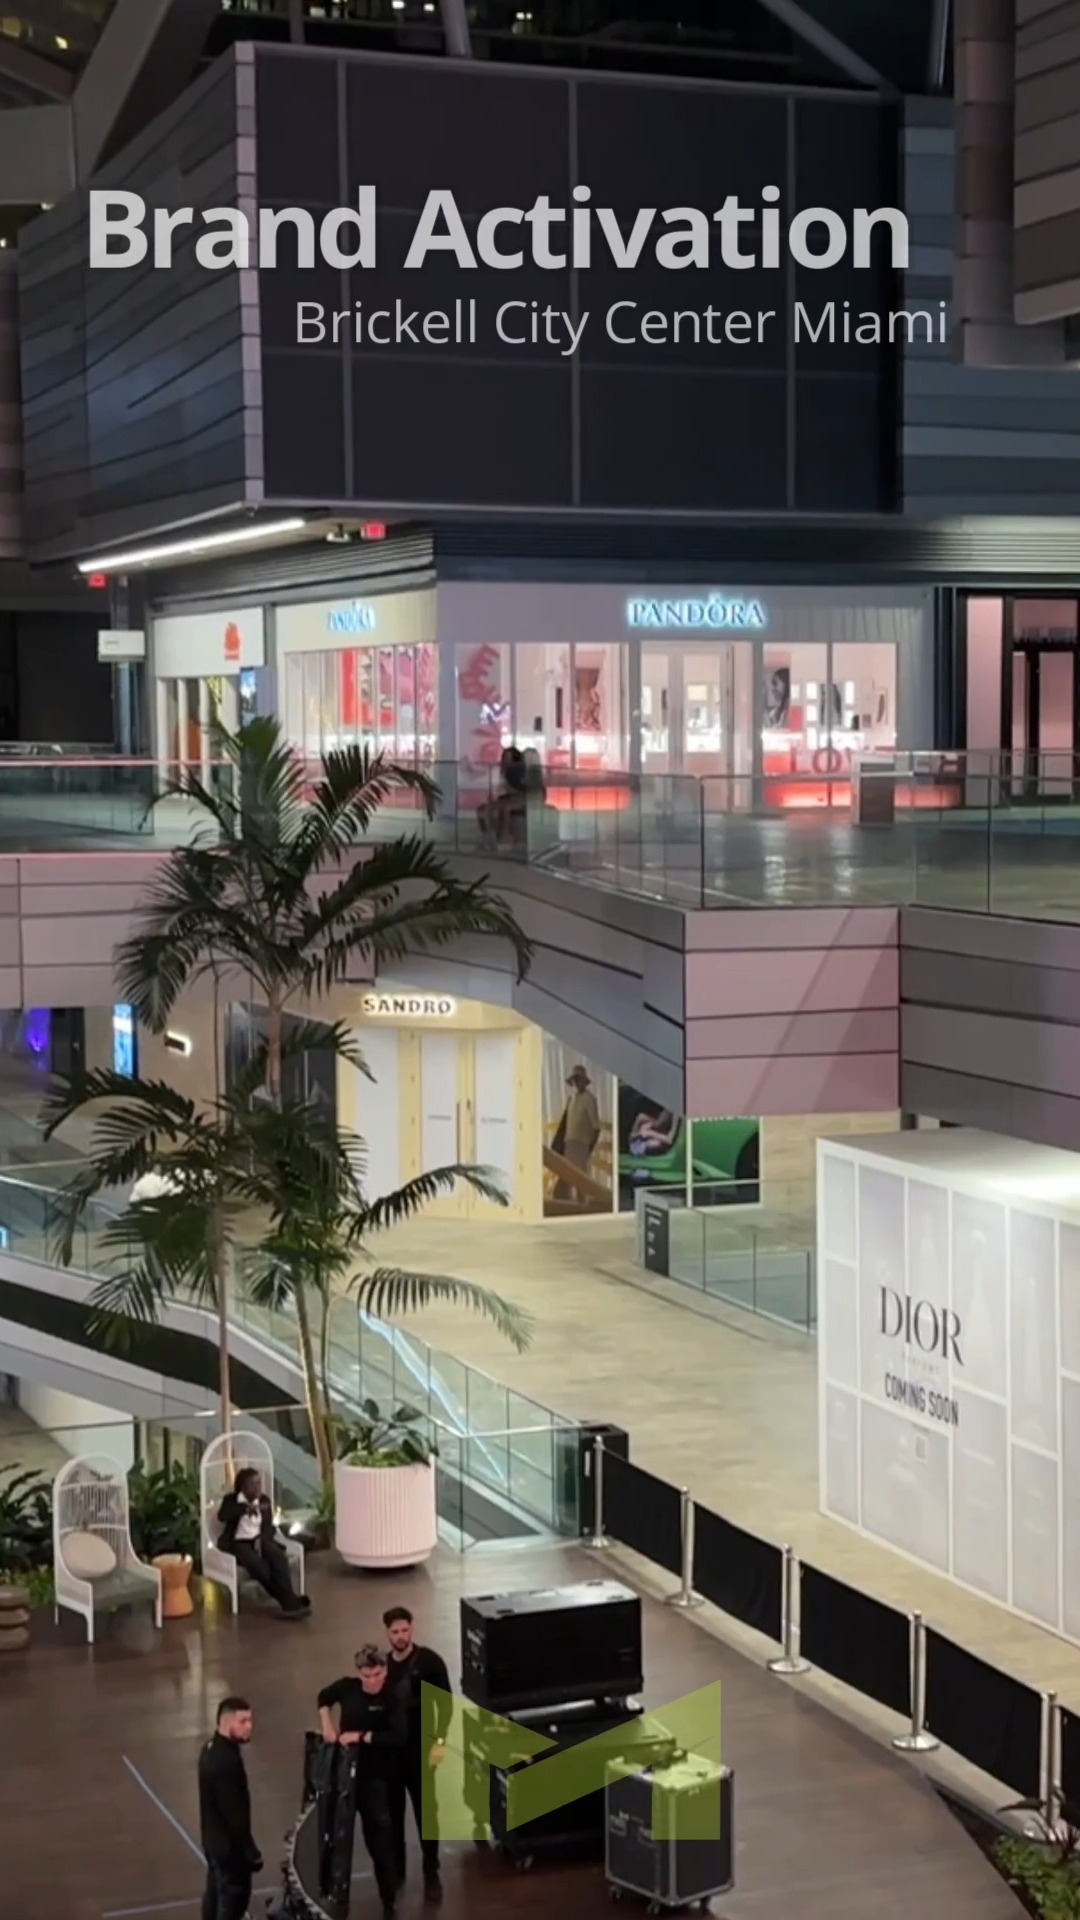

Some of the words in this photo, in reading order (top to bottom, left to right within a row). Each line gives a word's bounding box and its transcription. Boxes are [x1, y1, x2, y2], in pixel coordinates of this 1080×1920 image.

[628, 595, 766, 626] PANDORA
[362, 997, 453, 1015] SANDRO
[880, 1286, 964, 1367] DIOR
[885, 1372, 926, 1413] COMING
[928, 1391, 959, 1427] SOON
